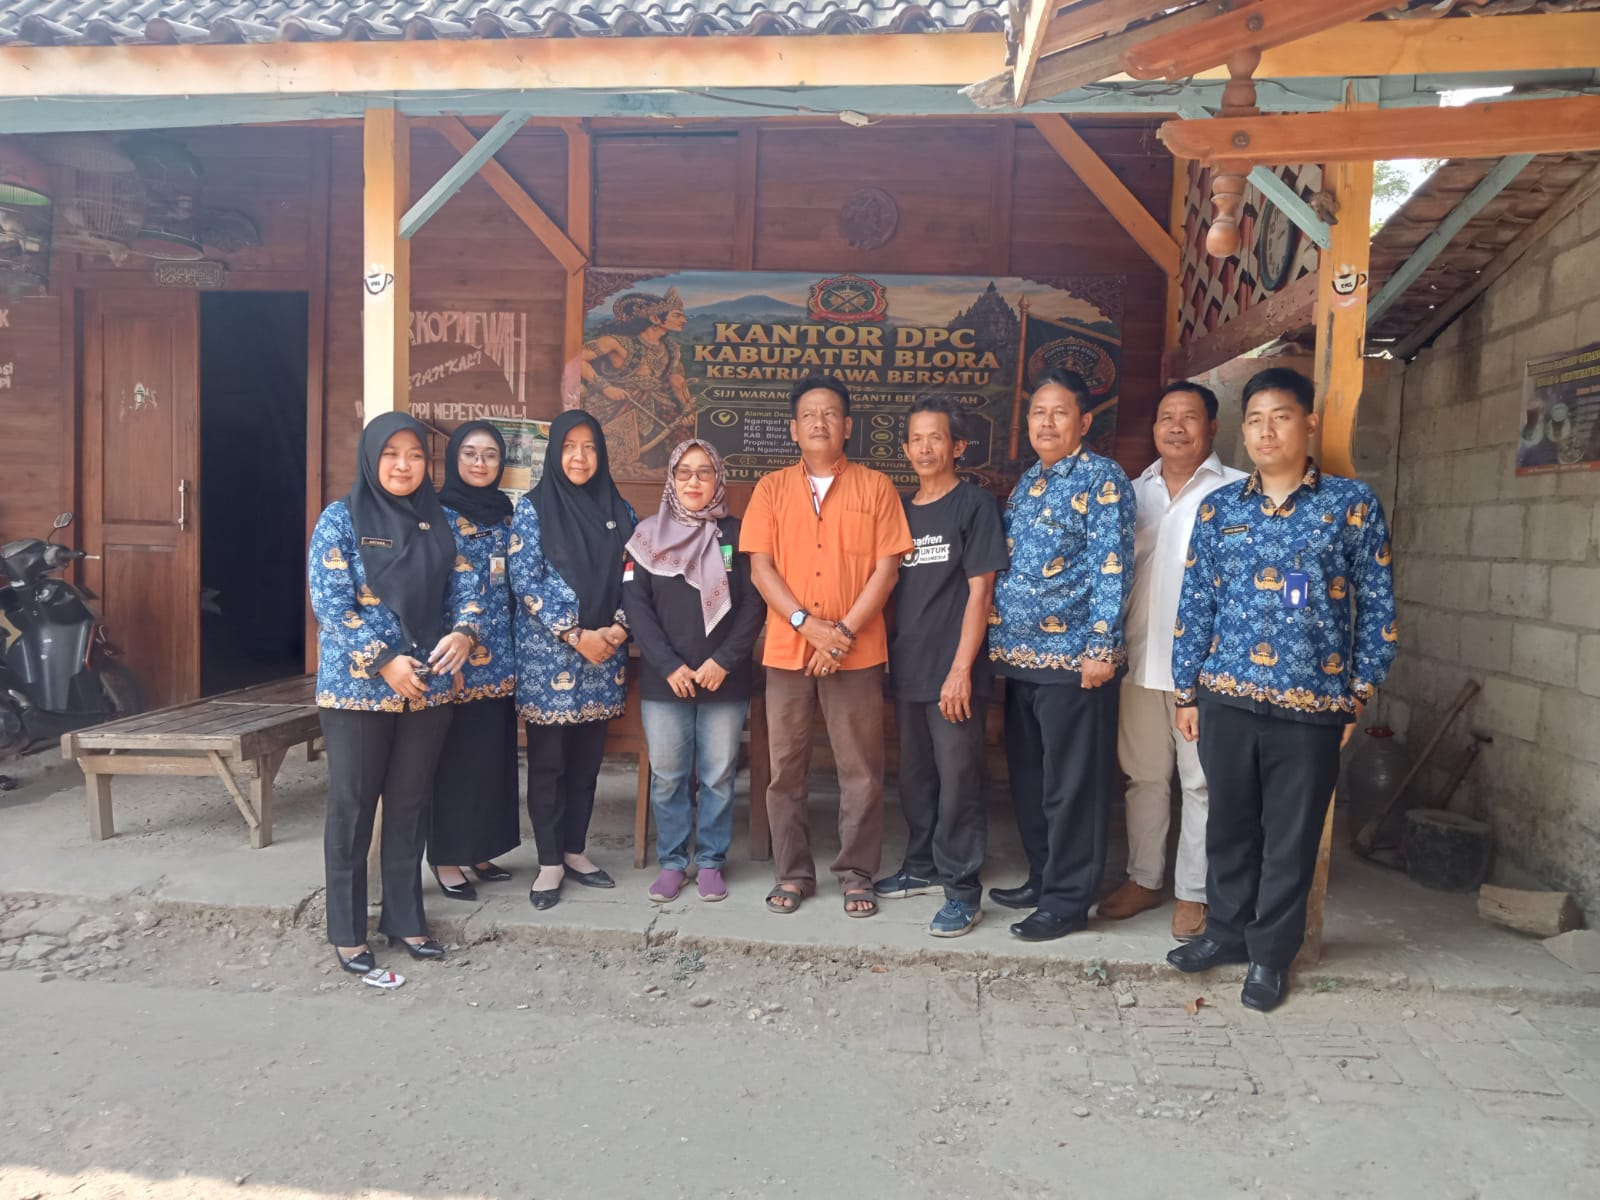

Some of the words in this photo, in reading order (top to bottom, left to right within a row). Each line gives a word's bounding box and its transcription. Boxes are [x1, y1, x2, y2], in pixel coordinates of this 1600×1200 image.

[715, 322, 883, 346] KANTOR
[895, 327, 976, 349] DPC
[694, 345, 884, 366] KABUPATEN
[894, 350, 1000, 369] BLORA
[887, 370, 989, 386] BERSATU
[713, 389, 735, 398] SIJI
[744, 418, 781, 427] Ngampel
[920, 546, 947, 555] UNTUK
